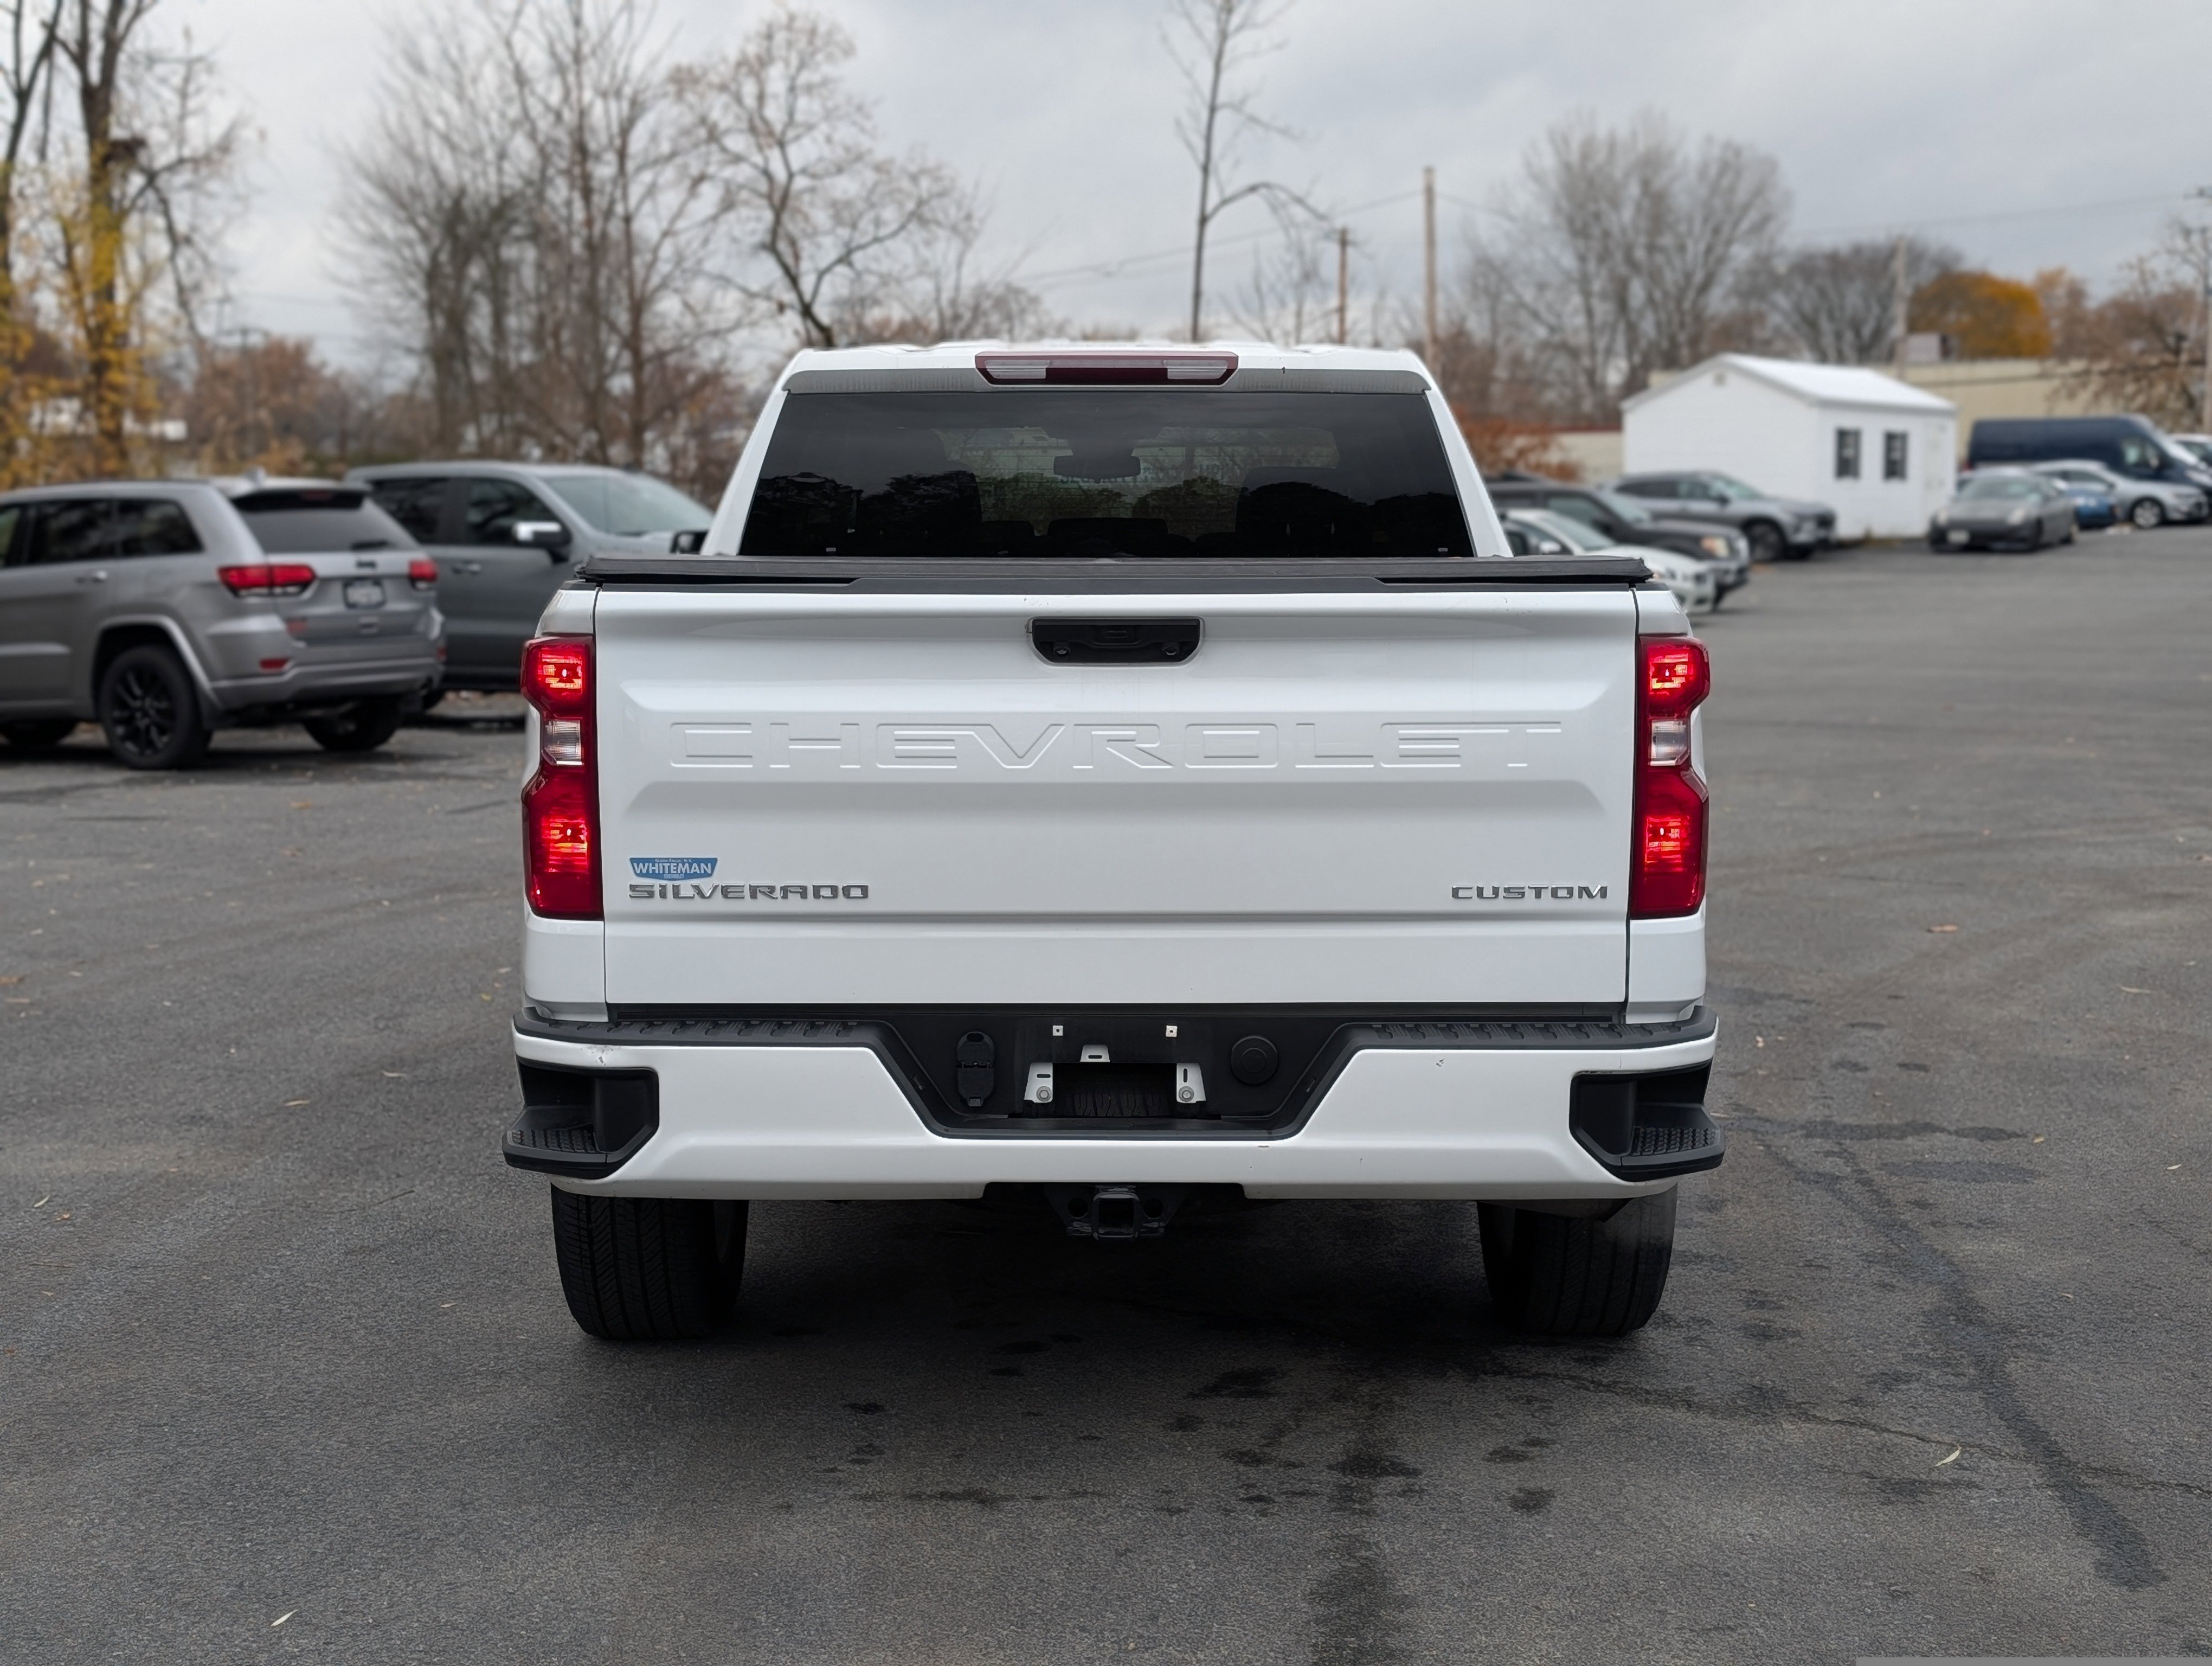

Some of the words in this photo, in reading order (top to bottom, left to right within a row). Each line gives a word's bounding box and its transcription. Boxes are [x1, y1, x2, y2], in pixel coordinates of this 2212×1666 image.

[670, 722, 1561, 768] CHEVROLET
[633, 862, 711, 874] WHITEMAN
[629, 883, 869, 900] SILVERADO
[1451, 884, 1608, 899] CUSTOM
